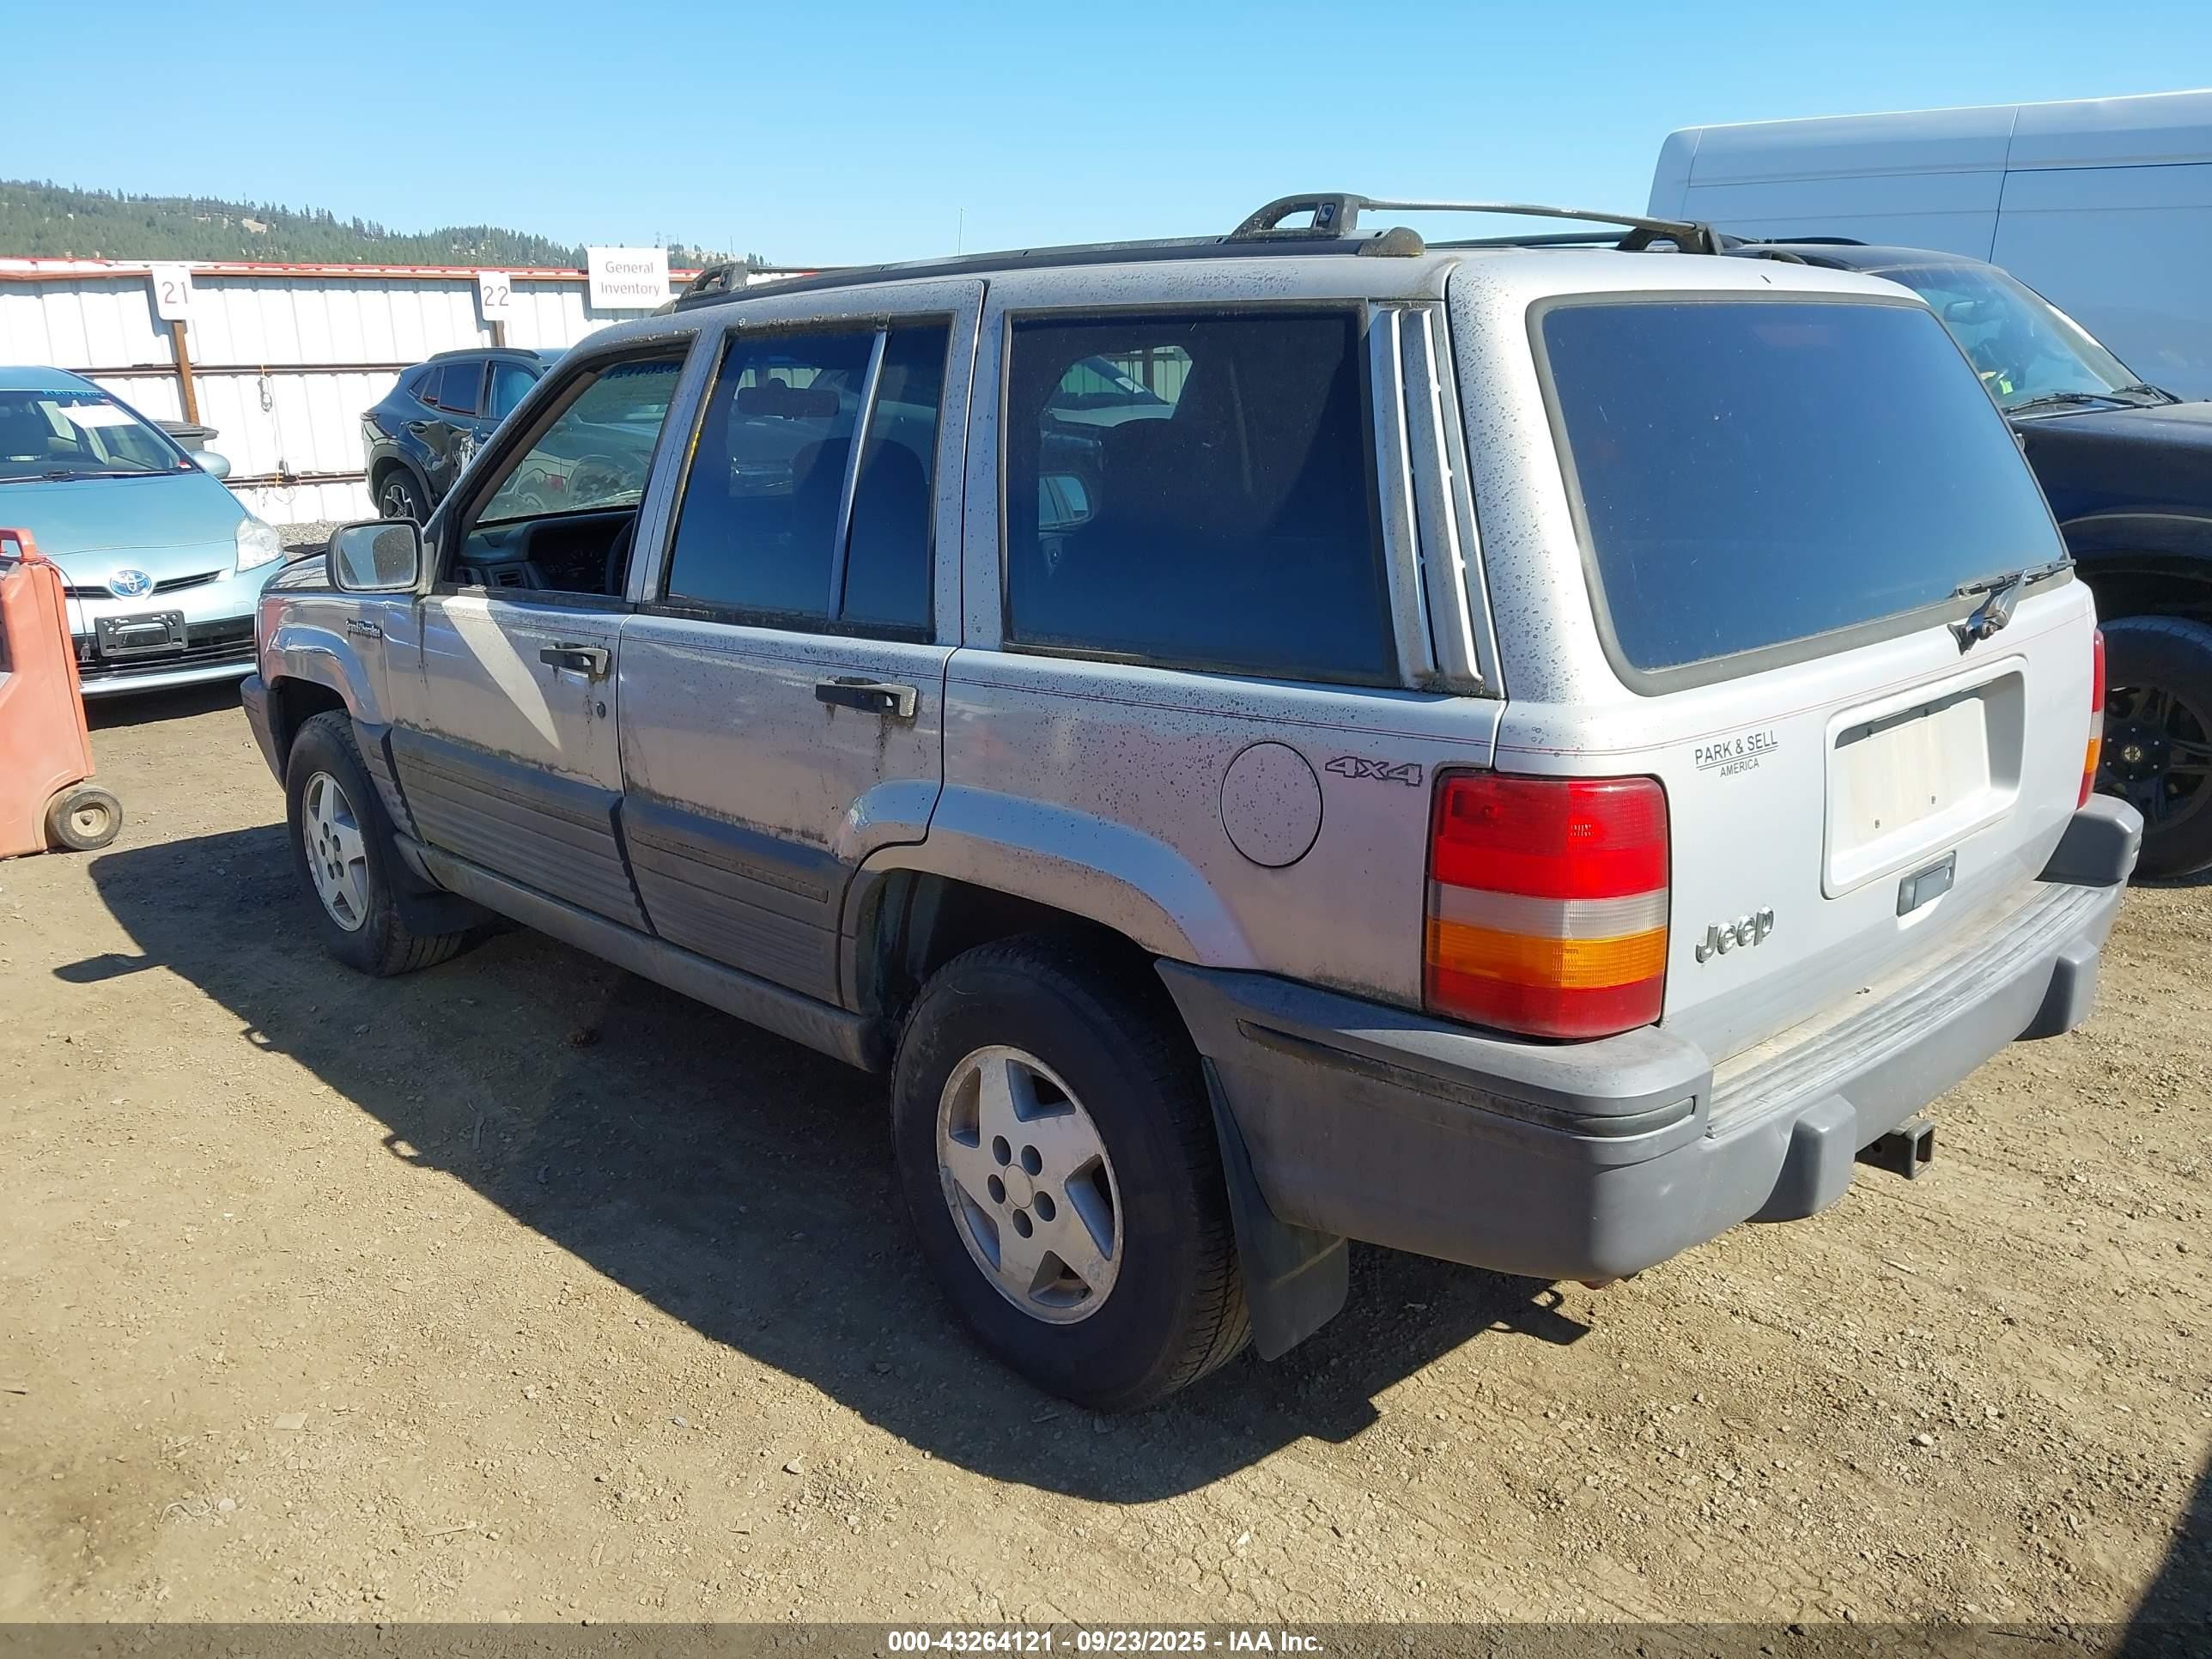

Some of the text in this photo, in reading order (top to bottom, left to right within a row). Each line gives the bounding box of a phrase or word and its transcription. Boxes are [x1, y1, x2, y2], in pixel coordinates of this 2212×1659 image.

[605, 261, 653, 273] General
[161, 281, 188, 304] 21
[483, 286, 509, 306] 22
[601, 282, 660, 296] Inventory
[1695, 730, 1778, 765] PARK & SELL
[1720, 757, 1760, 777] AMERICA
[1695, 906, 1774, 963] Jeep
